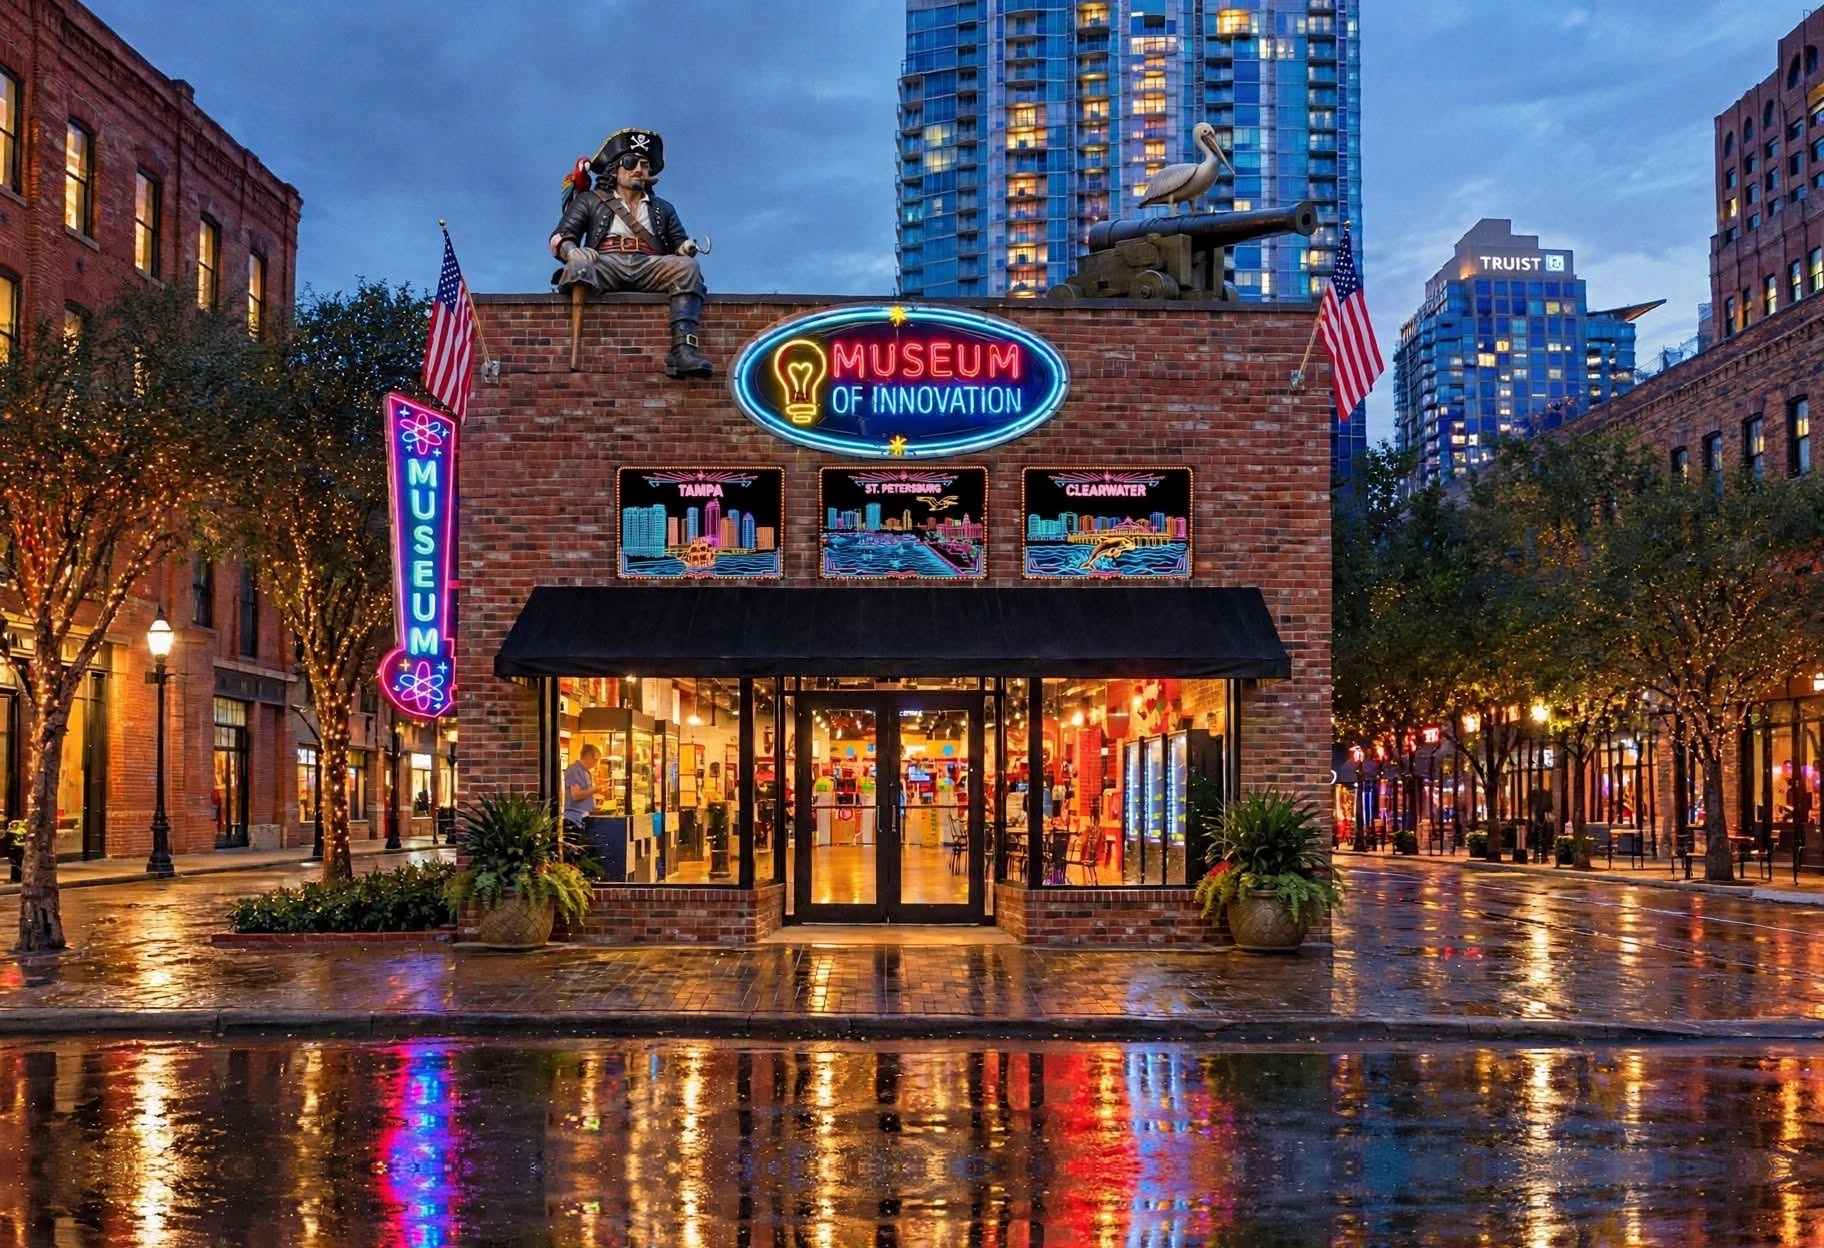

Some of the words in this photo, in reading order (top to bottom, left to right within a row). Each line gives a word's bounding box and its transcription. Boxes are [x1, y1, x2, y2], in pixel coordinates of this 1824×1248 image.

[1480, 256, 1541, 271] TRUIST
[833, 343, 1019, 379] MUSEUM
[832, 386, 863, 414] OF
[872, 386, 1022, 415] INNOVATION
[678, 483, 724, 497] TAMPA
[864, 483, 880, 494] ST.
[881, 483, 942, 494] PETERSBURG
[1065, 483, 1147, 496] CLEARWATER
[407, 458, 438, 655] MUSEUM
